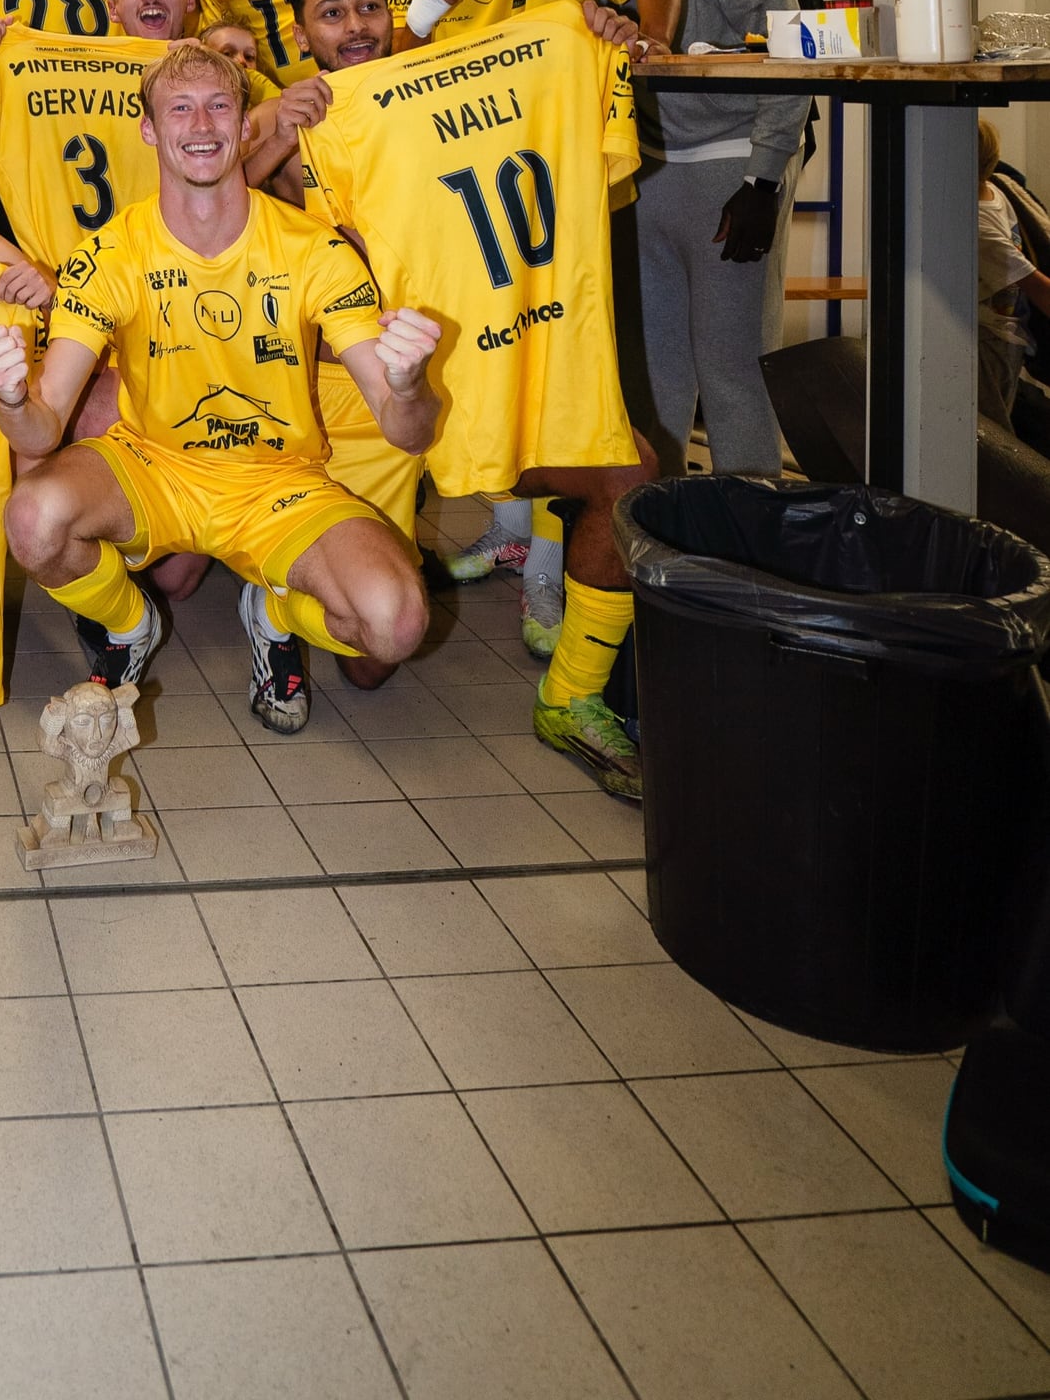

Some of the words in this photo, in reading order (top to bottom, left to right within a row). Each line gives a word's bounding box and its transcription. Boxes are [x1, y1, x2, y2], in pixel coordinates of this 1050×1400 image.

[28, 59, 144, 76] INTERSPOR
[396, 39, 545, 102] INTERSPORT
[435, 45, 469, 62] RESPECT,
[27, 88, 143, 119] GERVAIS
[431, 87, 524, 144] NAILI
[63, 133, 115, 231] 3
[437, 149, 556, 290] 10
[206, 417, 260, 436] PANIER
